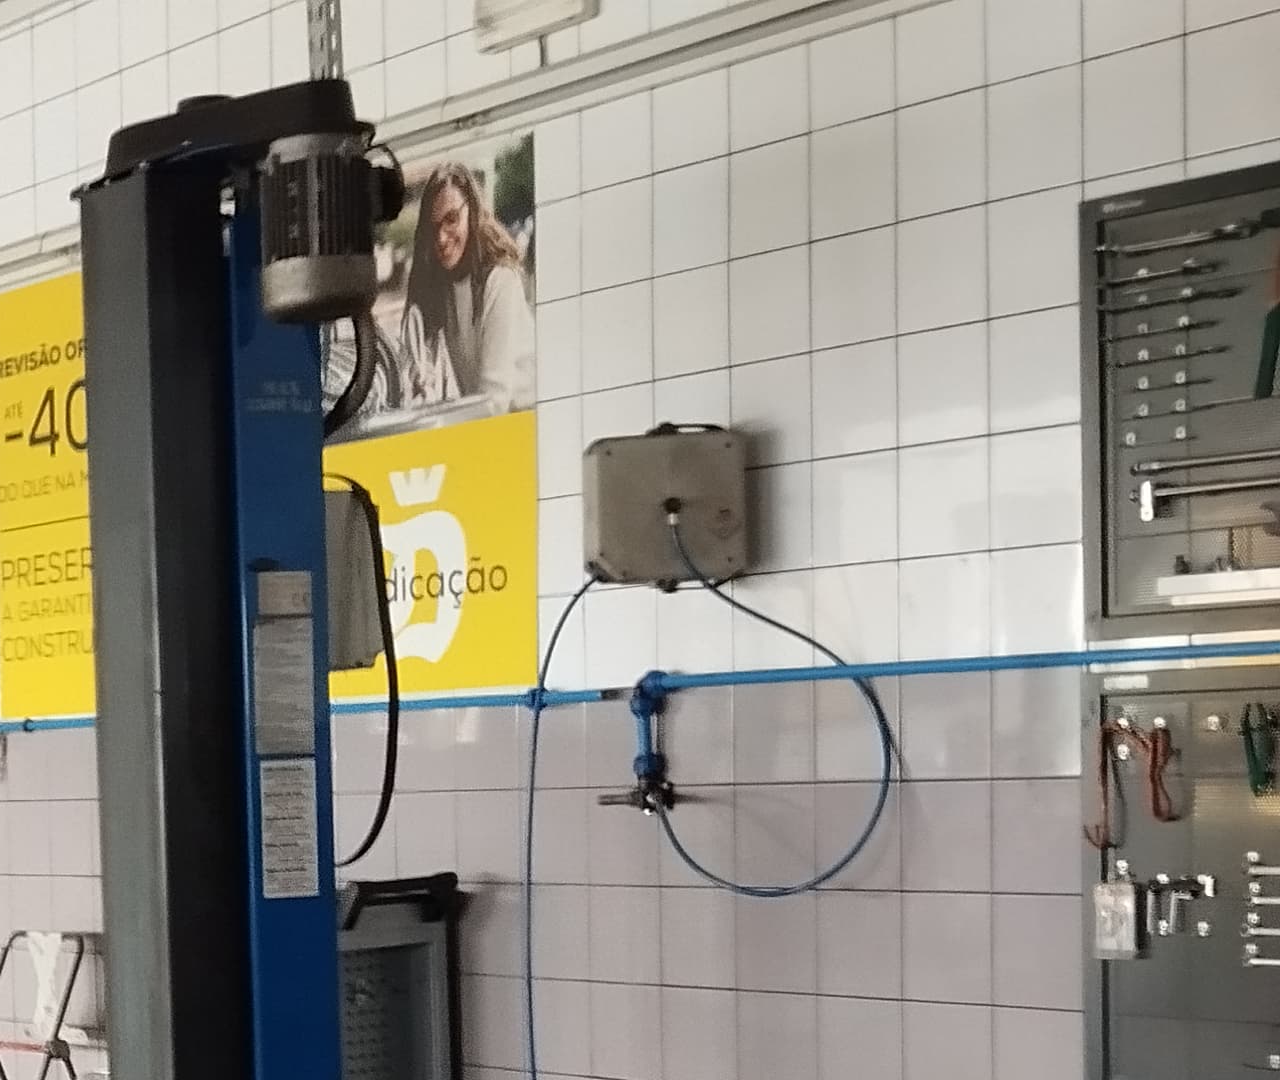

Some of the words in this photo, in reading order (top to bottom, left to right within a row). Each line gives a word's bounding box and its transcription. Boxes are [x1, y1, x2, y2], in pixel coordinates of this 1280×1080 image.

[1, 547, 92, 590] PRESER
[385, 556, 508, 608] dicação
[19, 593, 91, 621] GARANTI
[1, 630, 93, 662] CONSTRU
